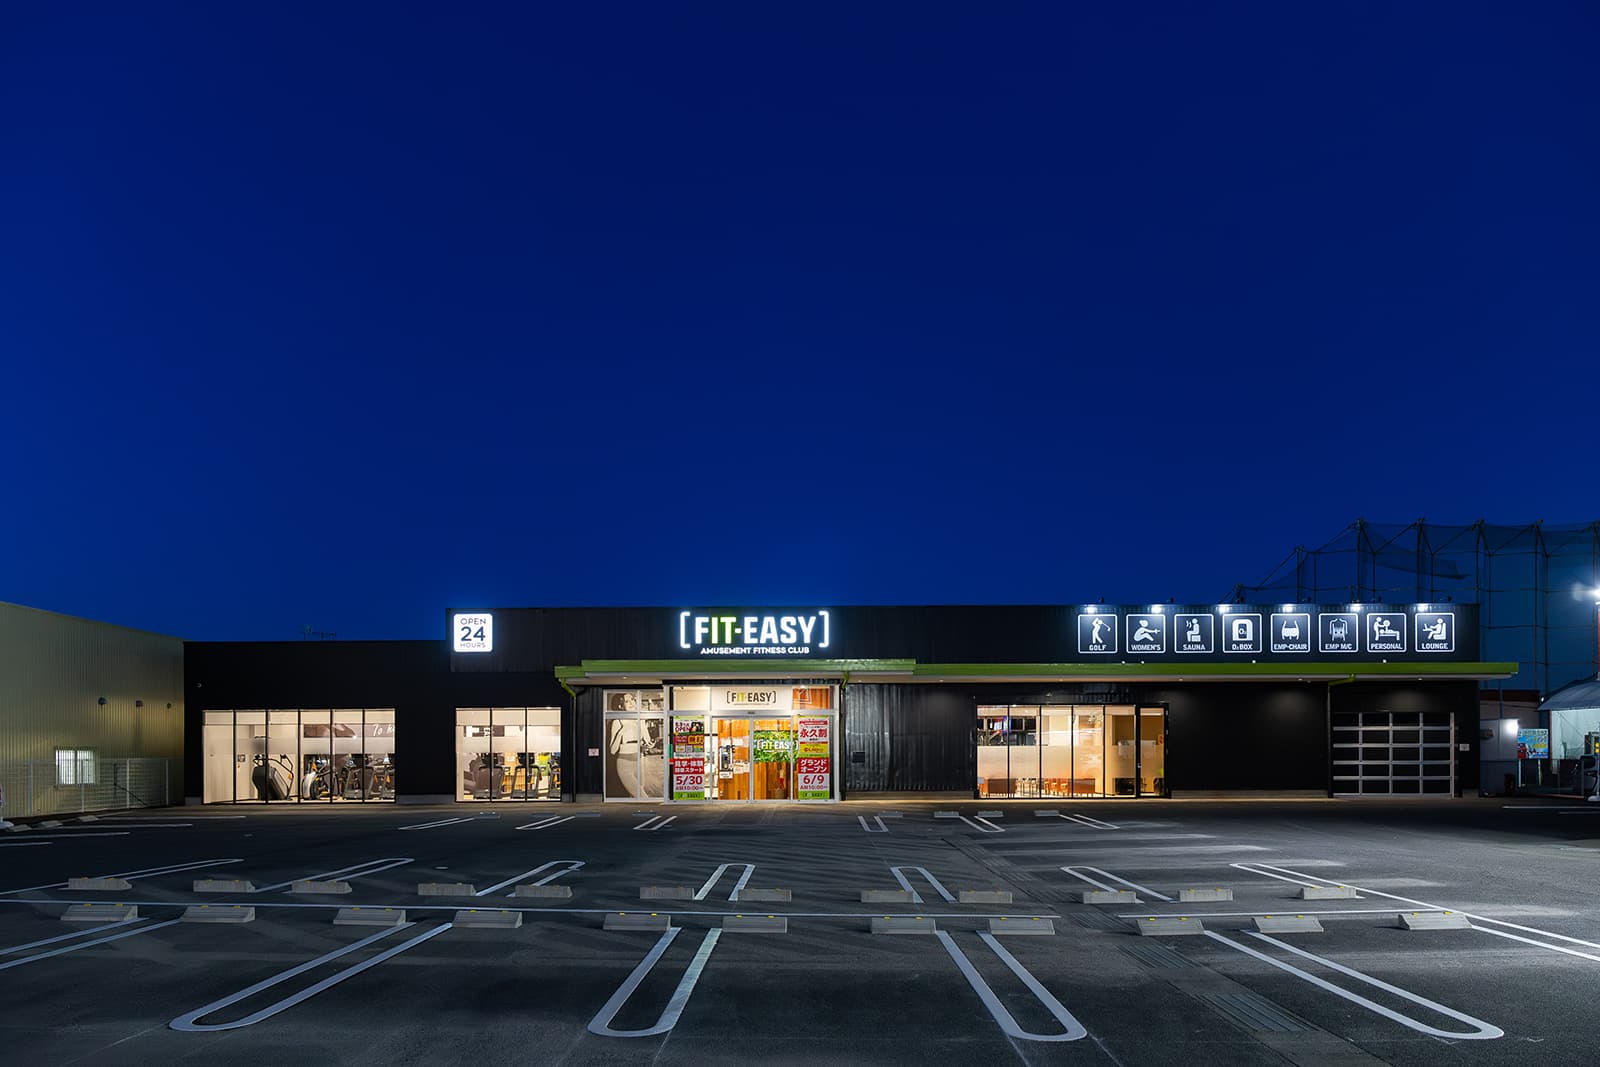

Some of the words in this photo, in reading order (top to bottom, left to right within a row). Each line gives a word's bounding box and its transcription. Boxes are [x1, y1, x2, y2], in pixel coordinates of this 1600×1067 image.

[461, 626, 486, 642] 24
[700, 647, 752, 655] AMUSEMENT
[787, 646, 810, 654] CLUB
[1421, 642, 1449, 650] LOUNGE
[799, 728, 828, 738] 永久割
[800, 759, 827, 767] グランド
[675, 775, 703, 786] 5/30
[803, 775, 825, 785] 6/9
